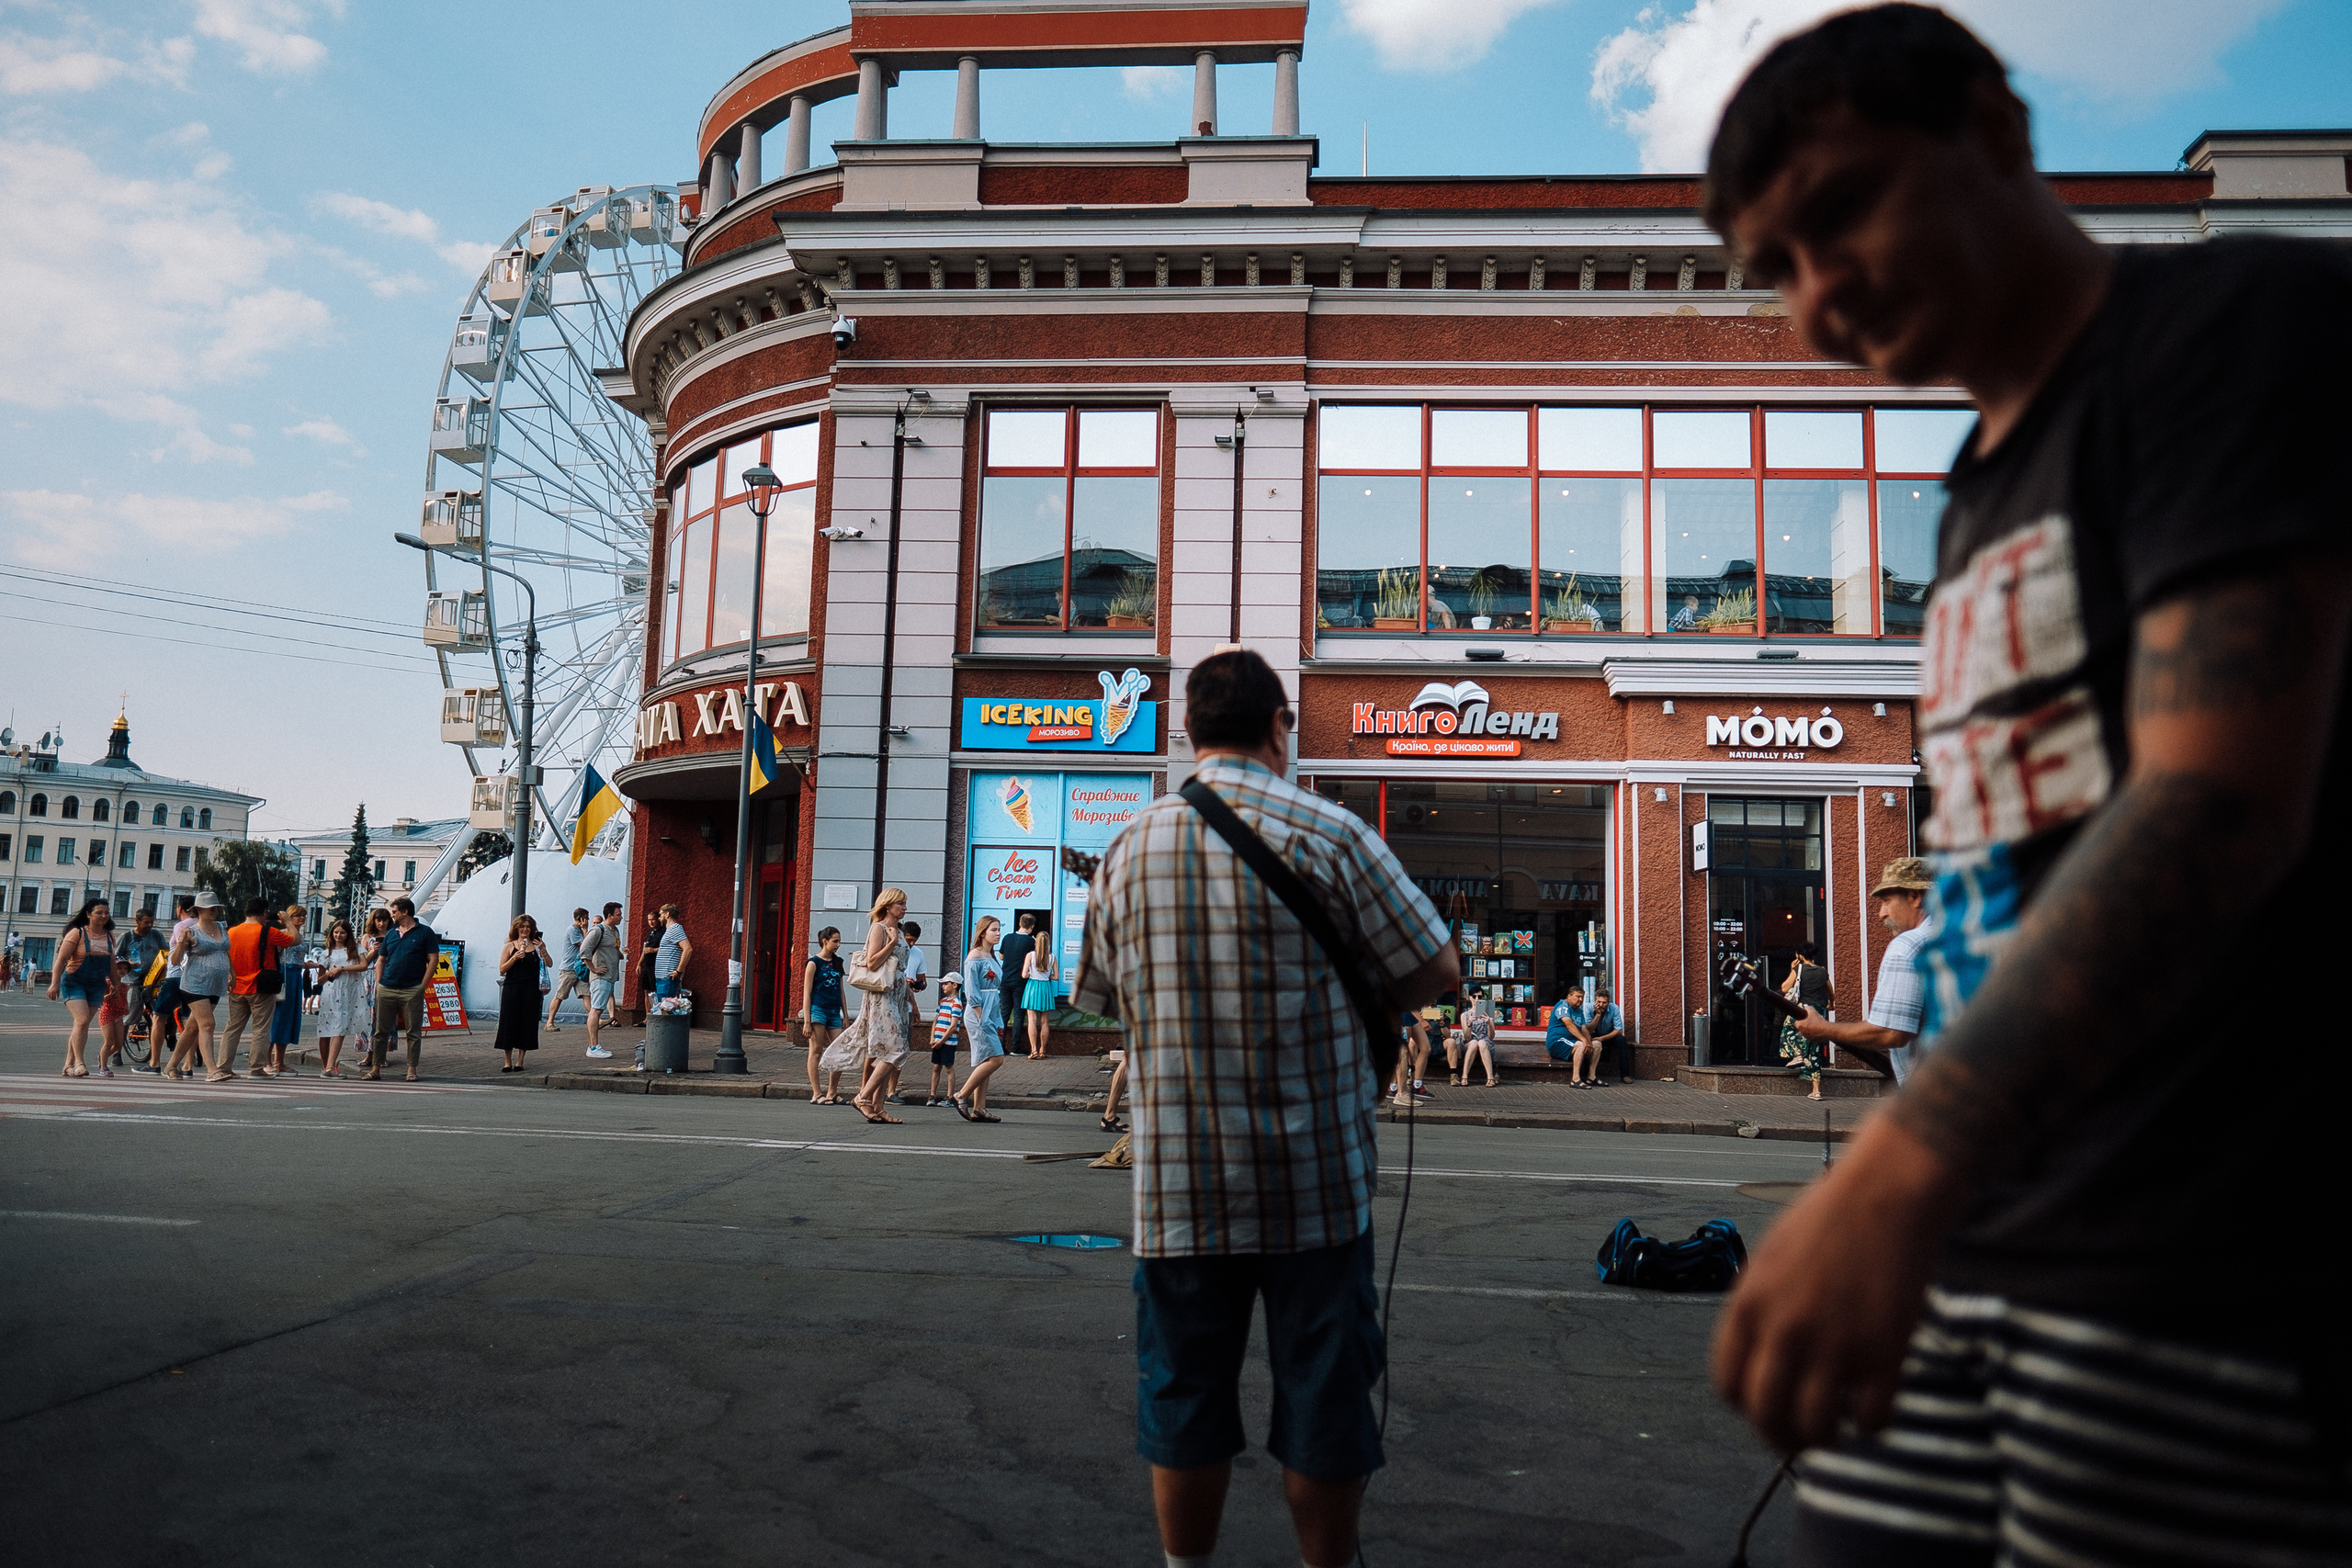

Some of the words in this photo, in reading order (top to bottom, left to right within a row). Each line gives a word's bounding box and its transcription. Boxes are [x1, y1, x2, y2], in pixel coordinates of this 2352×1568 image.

[634, 701, 682, 759] АТА
[692, 681, 811, 738] ХАТА
[980, 703, 1093, 727] ICEKING
[1352, 702, 1559, 739] КнигоЛенд
[1038, 728, 1080, 737] МОРОЗИВО
[1392, 740, 1431, 753] Країна,
[1433, 742, 1448, 754] де
[1450, 741, 1485, 752] цікаво
[1486, 741, 1515, 752] жити!
[1729, 750, 1780, 760] NATURALLY
[1782, 751, 1805, 761] FAST
[1003, 850, 1039, 874] Ice
[988, 867, 1037, 885] Cream
[996, 885, 1033, 901] Time
[435, 986, 457, 994] 2630
[440, 999, 459, 1008] 2980
[445, 1014, 460, 1022] 408
